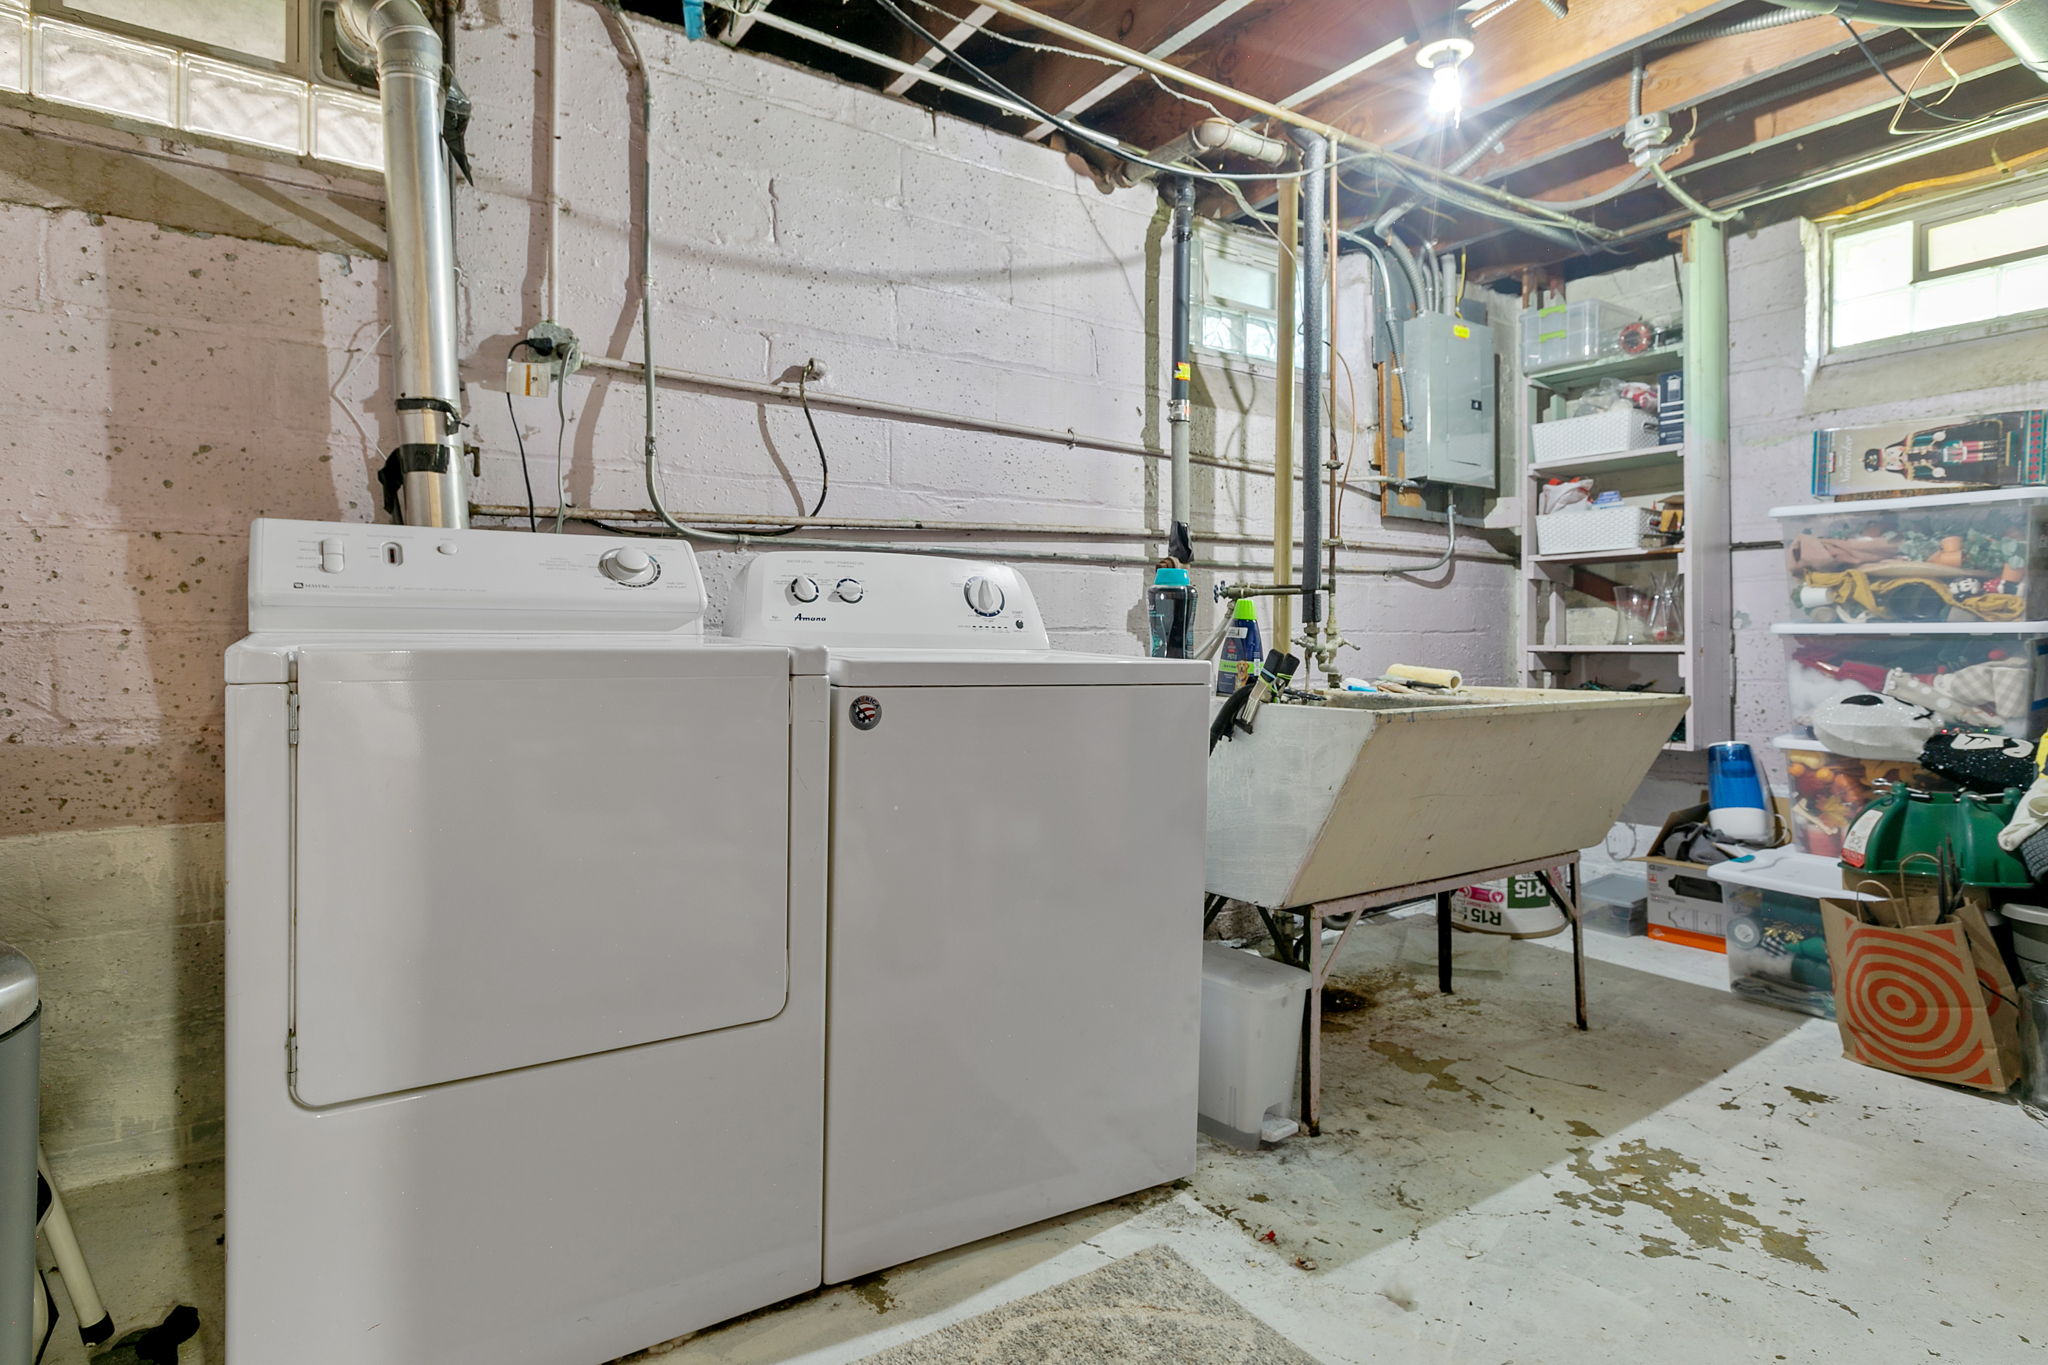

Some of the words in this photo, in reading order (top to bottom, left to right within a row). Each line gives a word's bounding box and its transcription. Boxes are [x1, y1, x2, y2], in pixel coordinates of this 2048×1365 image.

[794, 612, 827, 622] Amana
[852, 695, 880, 709] AMERICA
[1515, 881, 1546, 897] R15
[1471, 908, 1501, 925] R15
